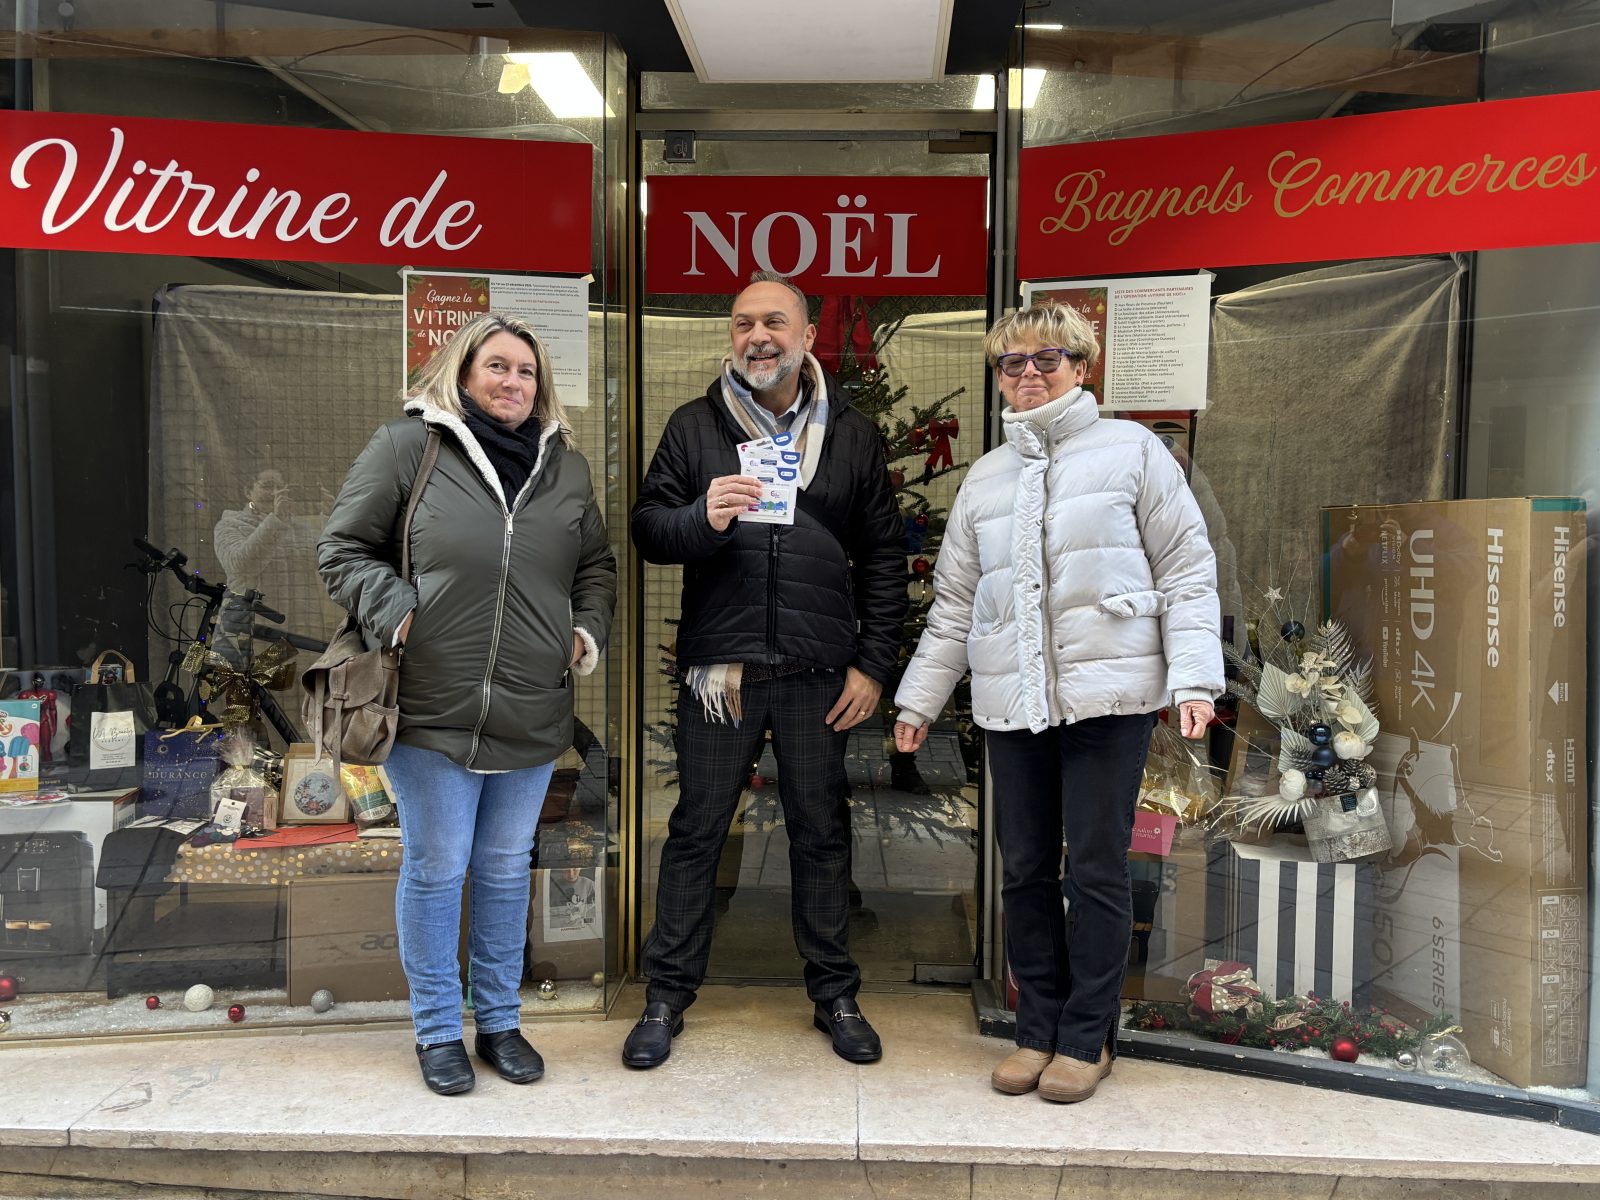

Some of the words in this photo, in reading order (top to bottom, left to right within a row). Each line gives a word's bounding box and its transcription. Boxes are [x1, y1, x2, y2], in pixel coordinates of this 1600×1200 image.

[10, 127, 359, 244] Vitrine
[379, 169, 483, 251] de
[1039, 165, 1253, 246] Bagnols
[1268, 150, 1597, 218] Commerces
[682, 194, 941, 278] NOËL
[427, 289, 460, 306] Gagnez
[463, 293, 473, 303] la
[428, 329, 456, 346] NO
[1381, 530, 1389, 564] NETFLIX
[1410, 529, 1435, 640] UHD
[1553, 526, 1570, 628] Hisense
[1487, 528, 1504, 668] Hisense
[1411, 650, 1436, 712] 4K
[361, 933, 399, 950] ac
[1432, 916, 1445, 930] 6
[1432, 934, 1445, 1009] SERIES
